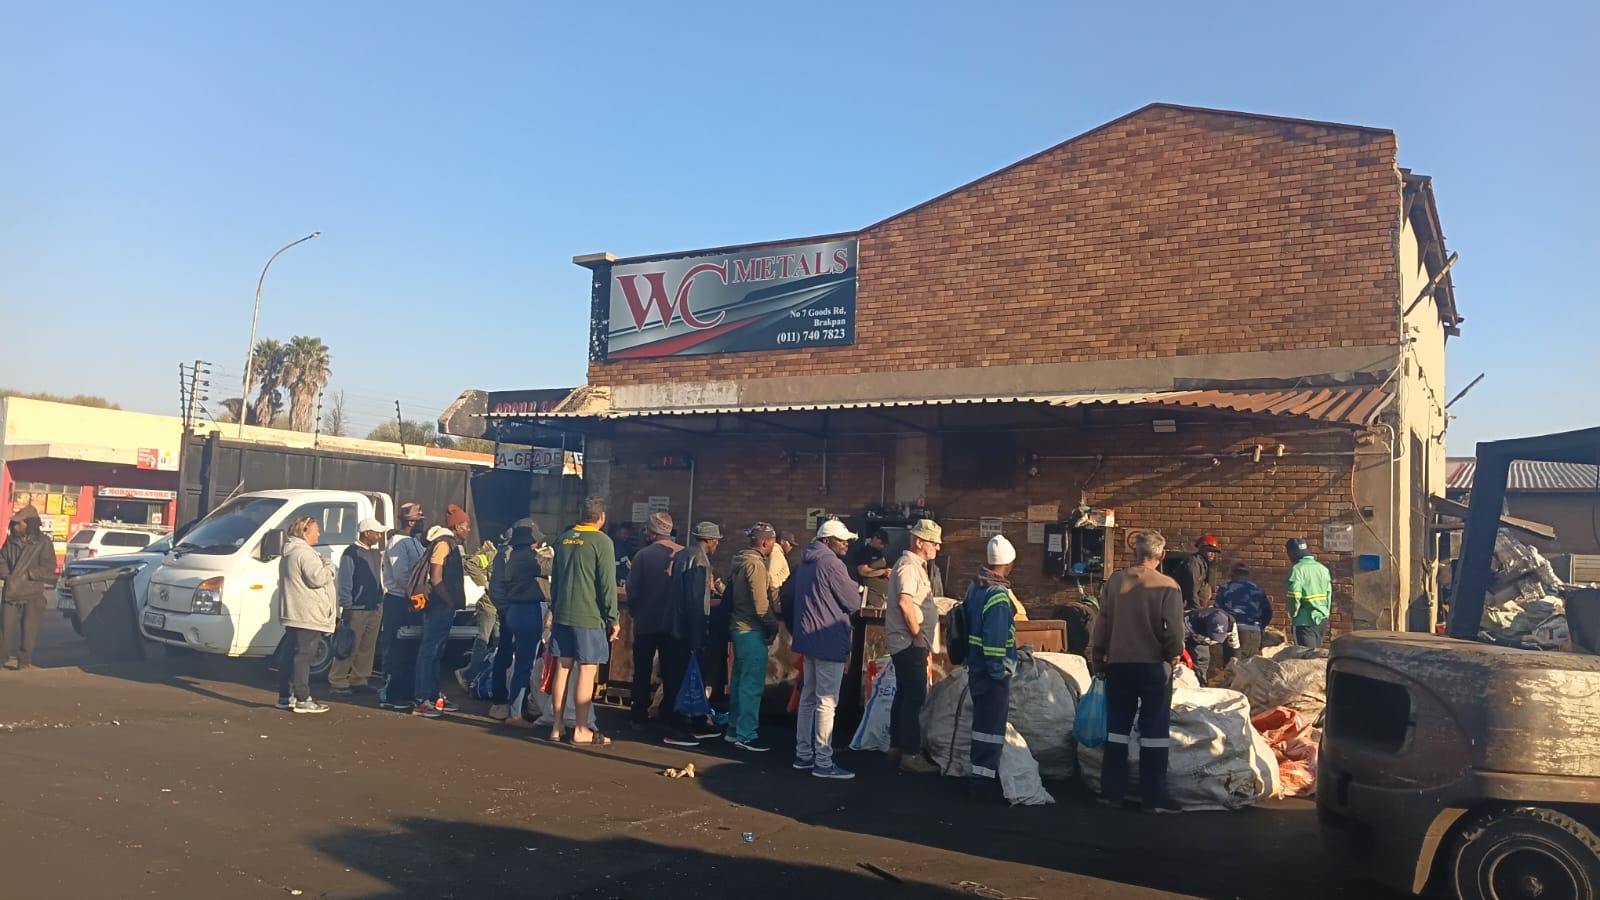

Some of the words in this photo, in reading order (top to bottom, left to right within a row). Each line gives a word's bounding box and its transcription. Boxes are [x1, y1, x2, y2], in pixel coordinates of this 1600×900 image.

[616, 259, 727, 332] WC
[732, 248, 848, 283] METALS
[790, 310, 801, 318] No
[802, 309, 807, 317] 7
[808, 308, 832, 317] Goods
[833, 306, 847, 317] Rd,
[813, 318, 846, 328] Brakpan
[777, 331, 801, 344] (011)
[802, 330, 821, 341] 740
[822, 329, 846, 340] 7823
